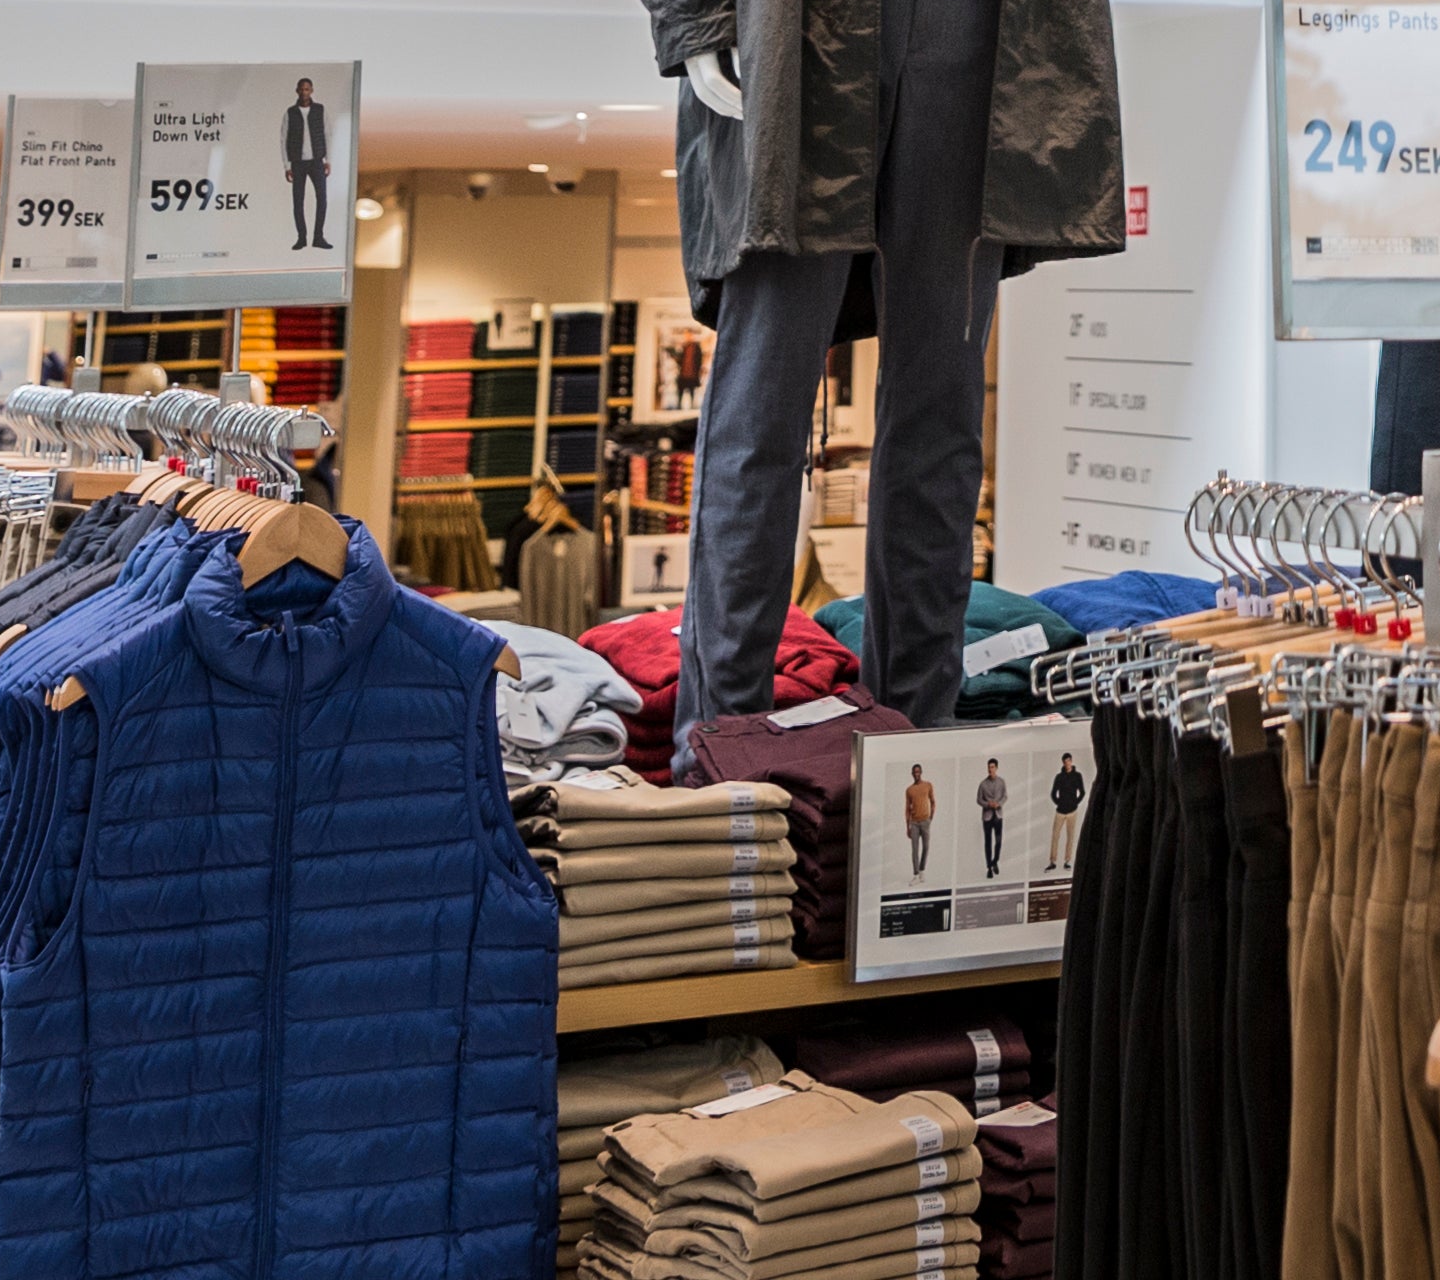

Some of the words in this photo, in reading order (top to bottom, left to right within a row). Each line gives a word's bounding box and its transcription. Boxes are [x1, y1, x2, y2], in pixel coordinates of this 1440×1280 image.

[1299, 7, 1380, 33] Leggings
[1389, 10, 1439, 30] Pants
[153, 113, 186, 125] Ultra
[192, 113, 225, 127] Light
[153, 130, 188, 142] Down
[194, 130, 221, 141] Vest
[1304, 118, 1396, 173] 249
[22, 141, 46, 152] Slim
[52, 141, 67, 151] Fit
[72, 141, 103, 151] Chino
[21, 156, 43, 166] Flat
[48, 156, 80, 166] Front
[85, 156, 116, 167] Pants
[151, 178, 214, 212] 599
[215, 194, 249, 210] SEK
[17, 198, 74, 227] 399
[74, 213, 104, 226] SEK
